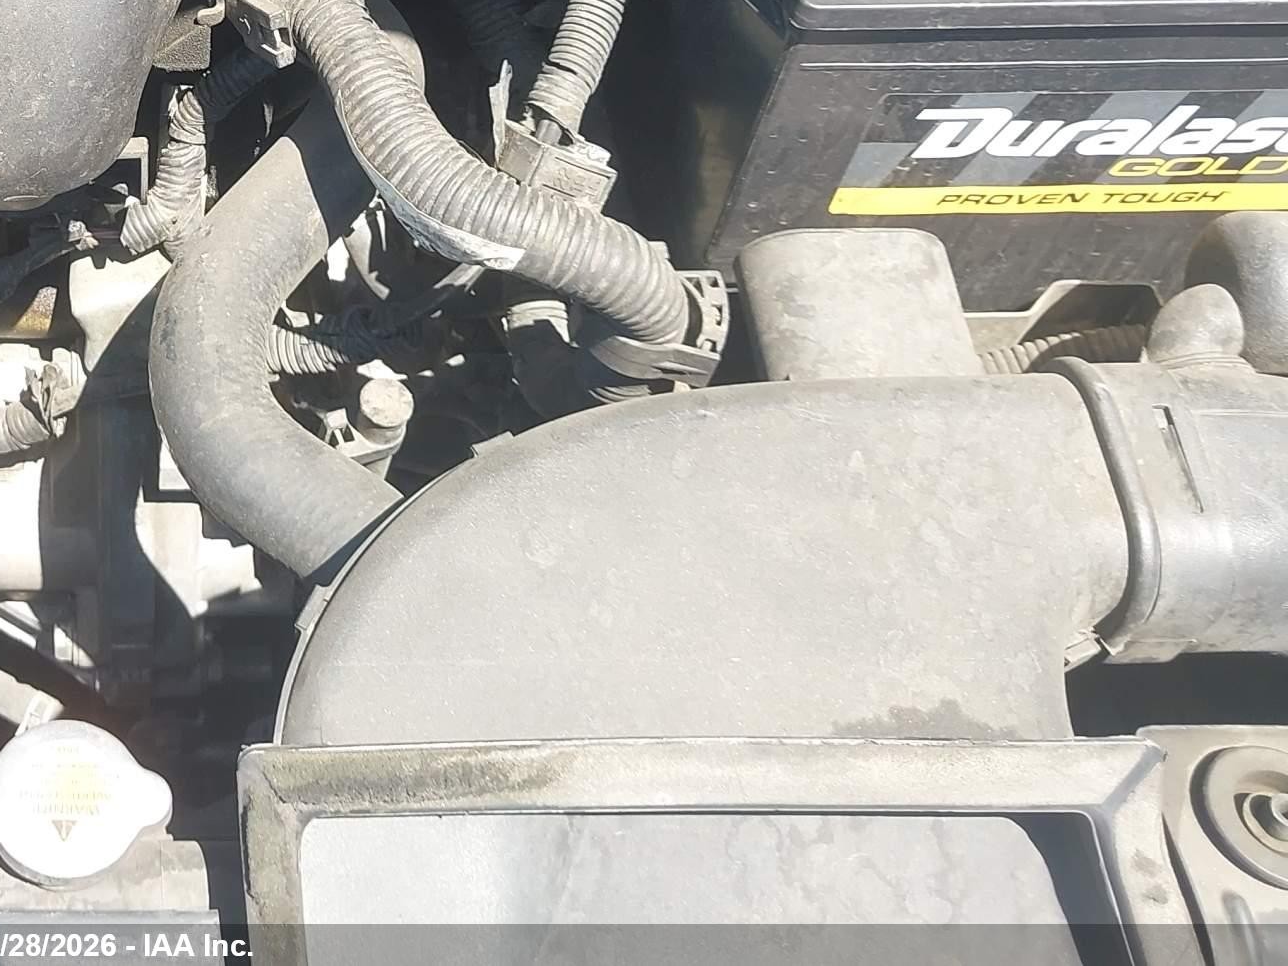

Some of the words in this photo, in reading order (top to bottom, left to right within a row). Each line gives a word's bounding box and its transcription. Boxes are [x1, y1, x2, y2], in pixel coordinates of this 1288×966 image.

[1108, 156, 1288, 177] GOLD
[936, 192, 1090, 206] PROVEN
[1102, 191, 1226, 204] TOUGH
